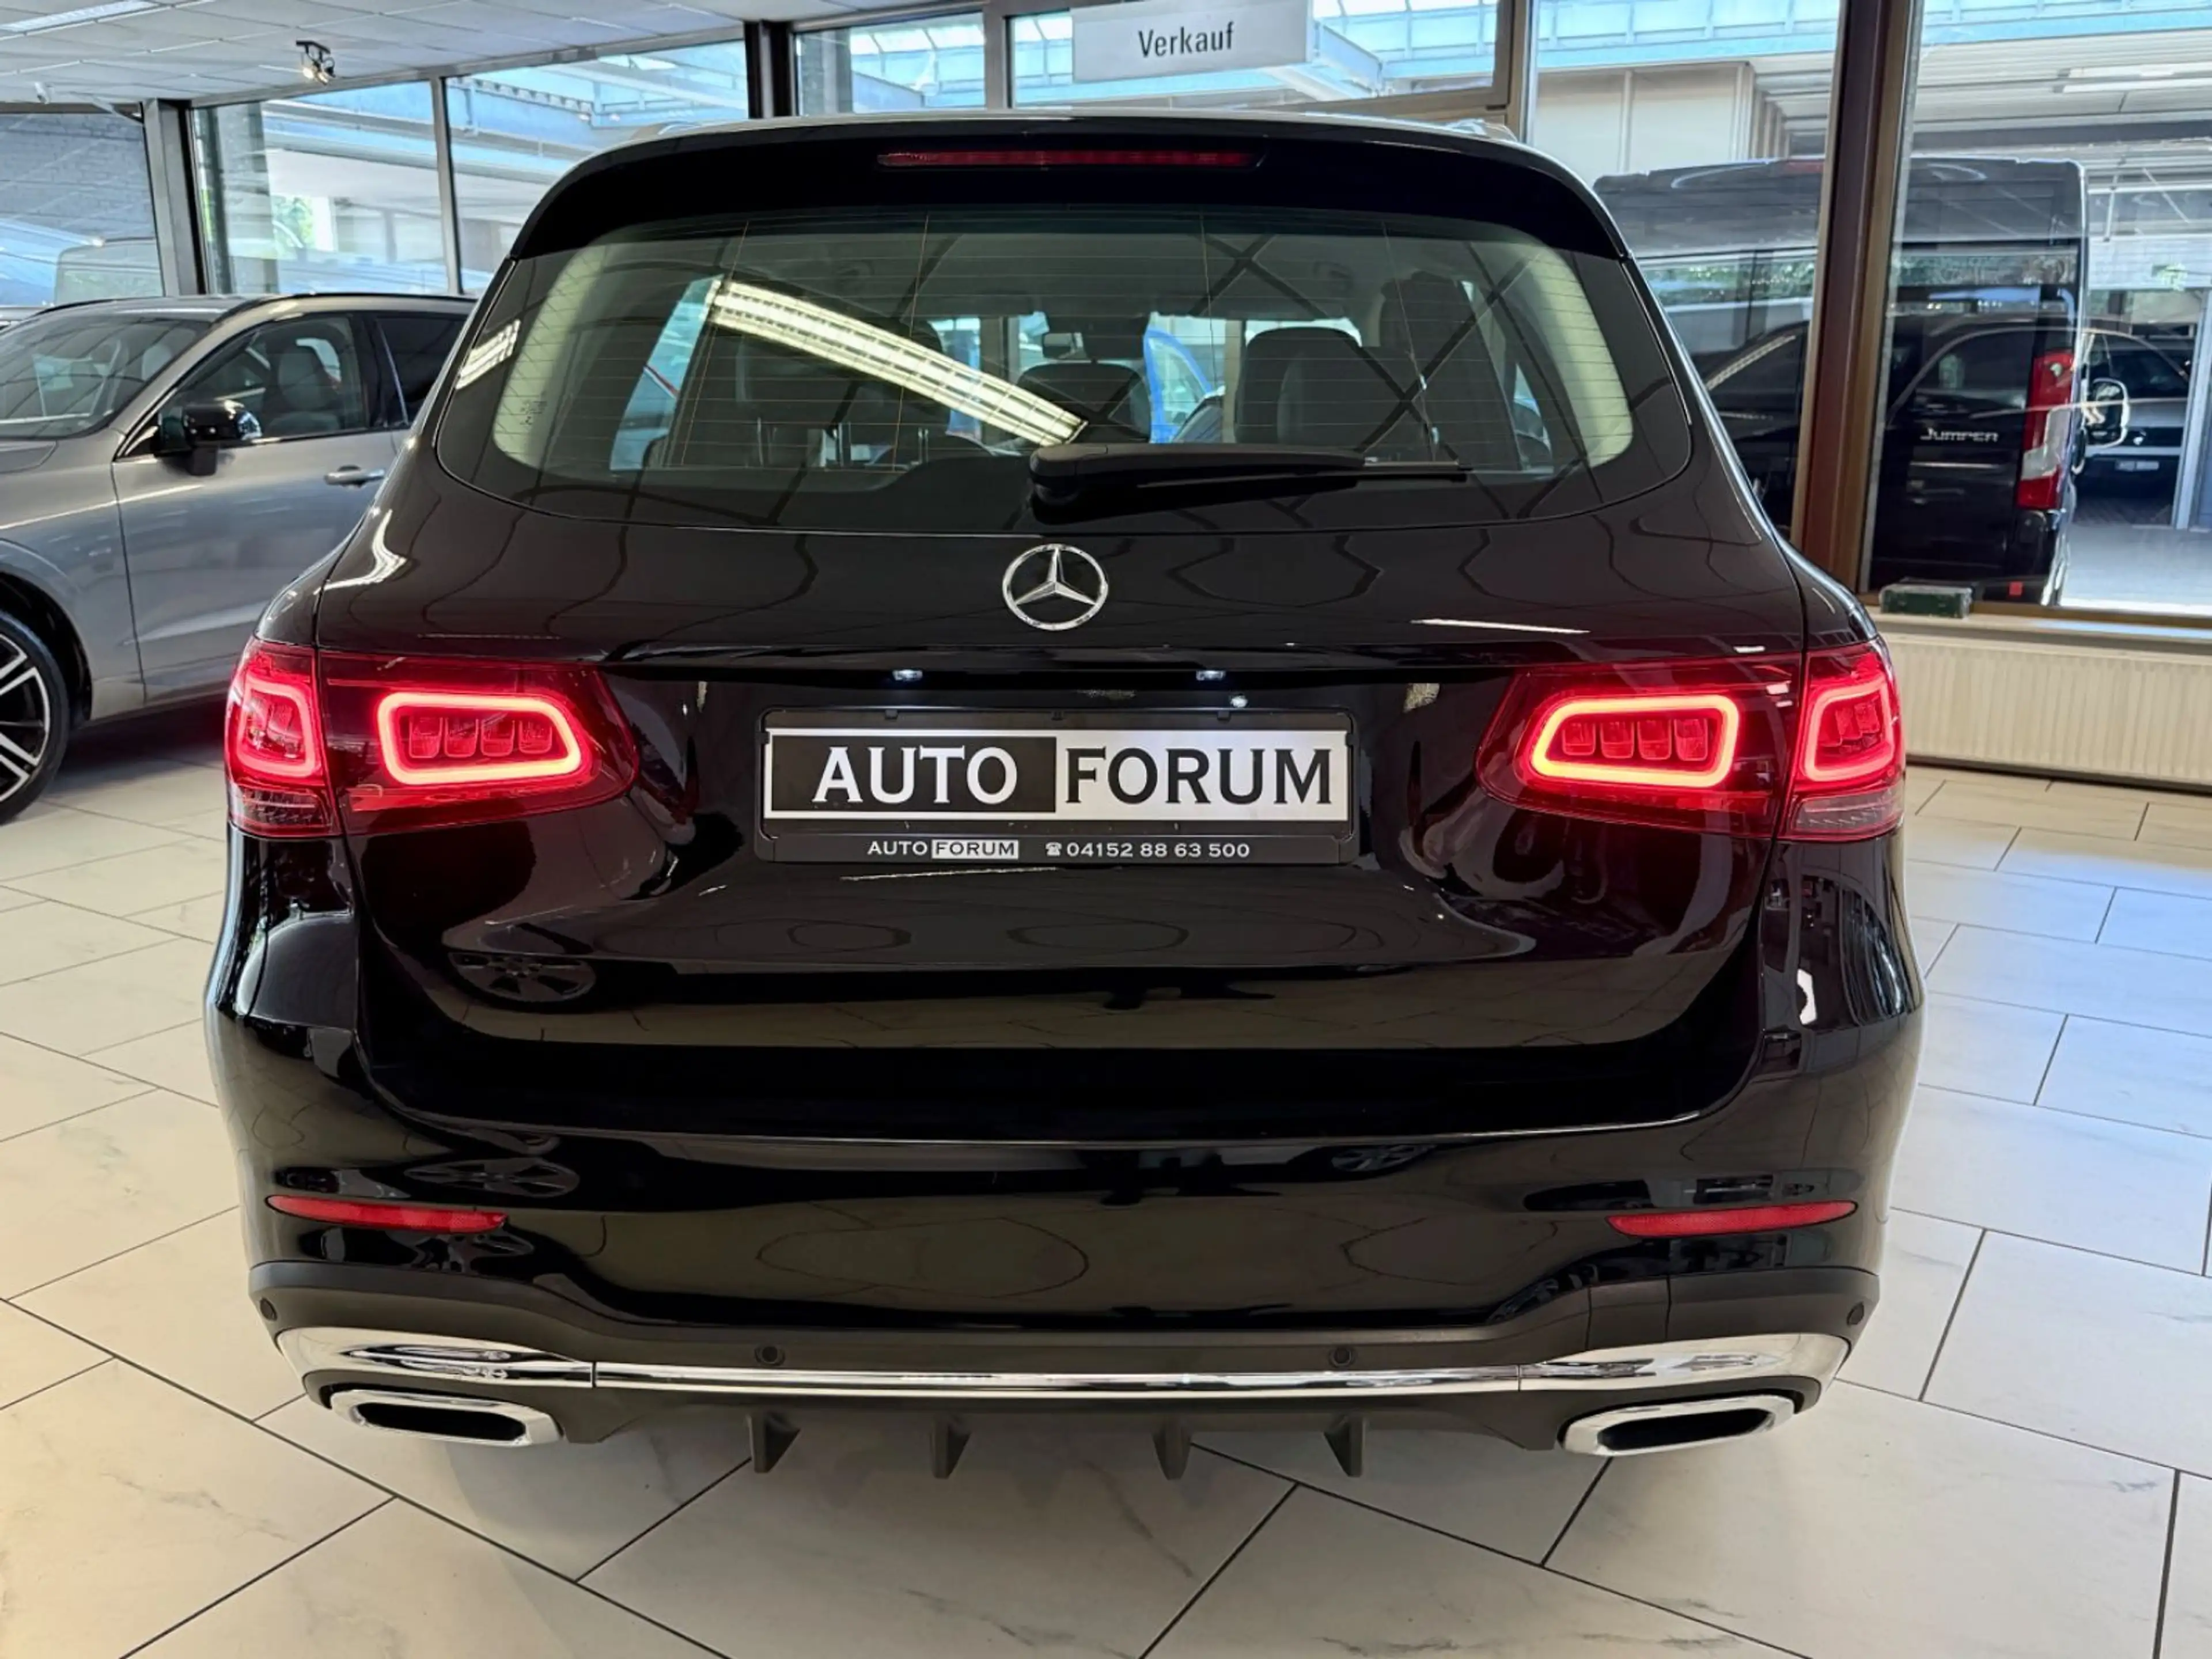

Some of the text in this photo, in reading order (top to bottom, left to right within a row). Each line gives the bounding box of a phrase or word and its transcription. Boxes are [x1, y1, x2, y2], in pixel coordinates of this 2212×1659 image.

[1138, 21, 1234, 58] Verkauf
[812, 745, 1332, 804] AUTO FORUM
[867, 840, 1250, 858] AUTO FORUM 04152 88 63 500
